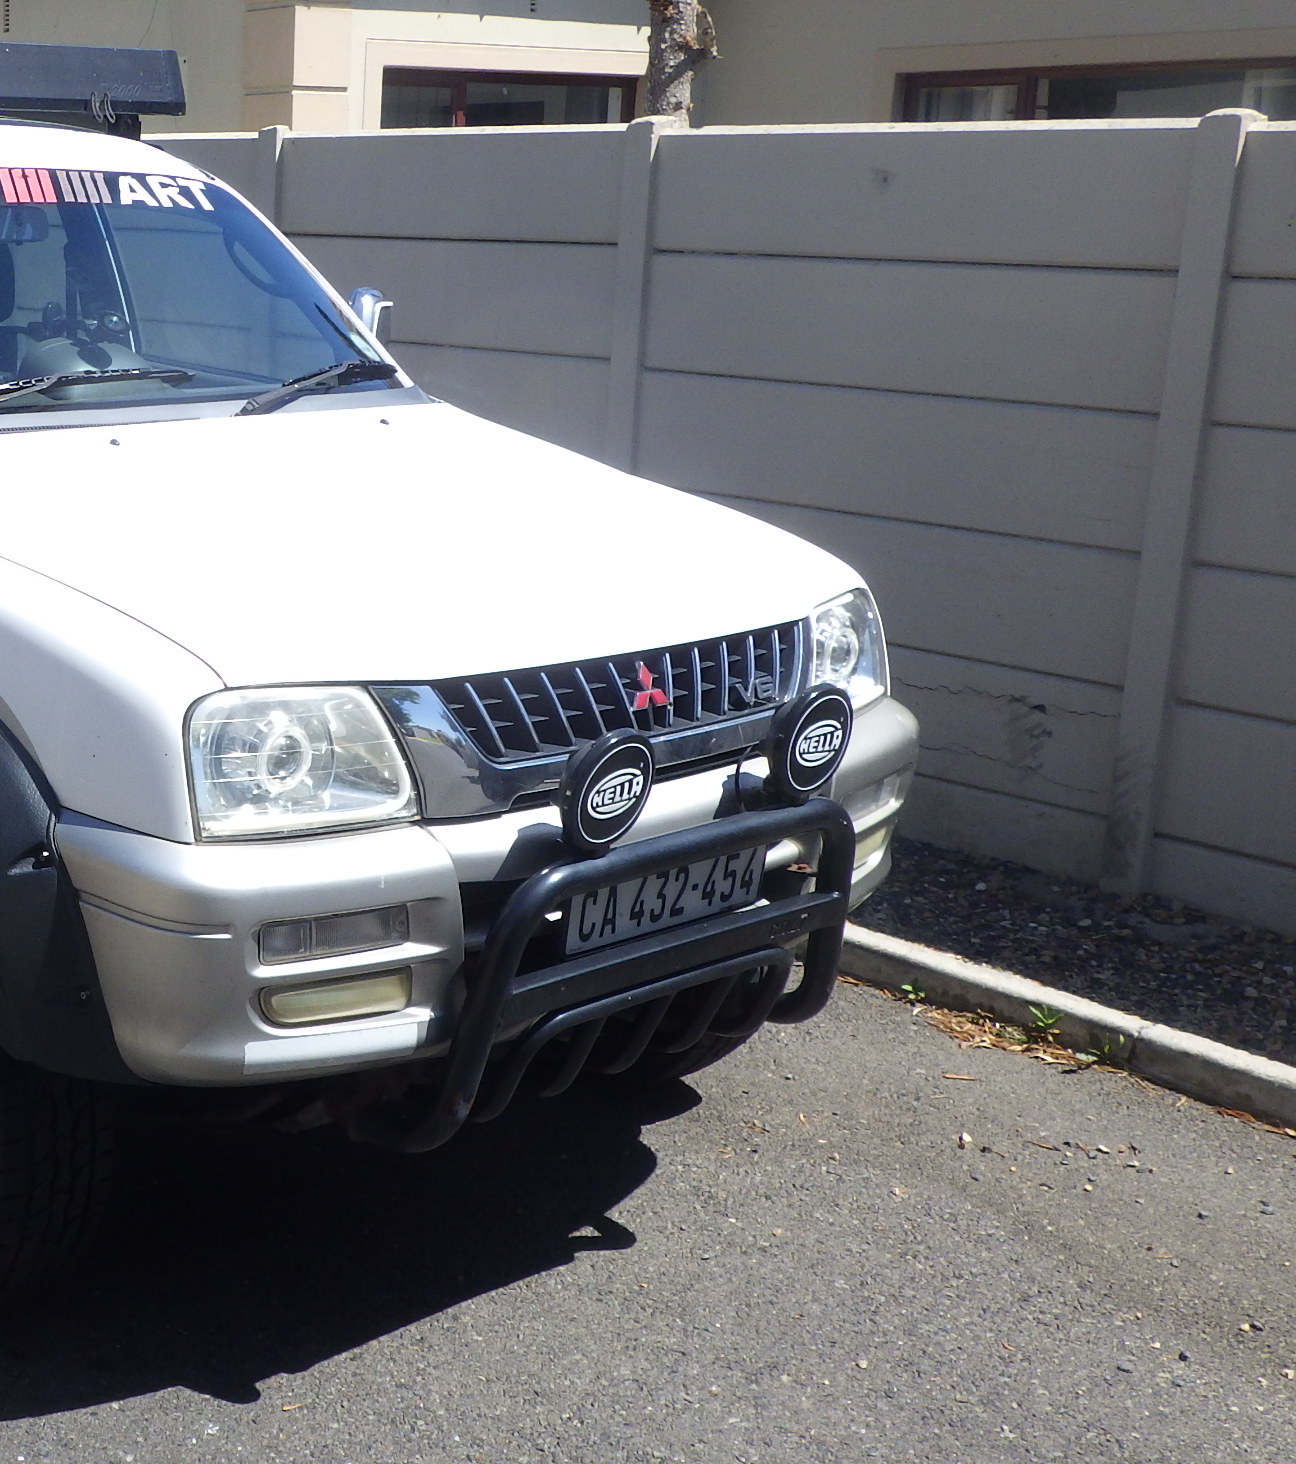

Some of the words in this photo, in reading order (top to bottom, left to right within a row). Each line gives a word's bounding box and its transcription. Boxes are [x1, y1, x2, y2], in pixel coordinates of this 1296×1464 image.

[118, 175, 214, 211] ART
[735, 676, 774, 704] V6
[800, 730, 843, 754] HELLA
[593, 775, 643, 807] HELLA
[579, 884, 617, 942] CA
[629, 848, 758, 927] 432-454
